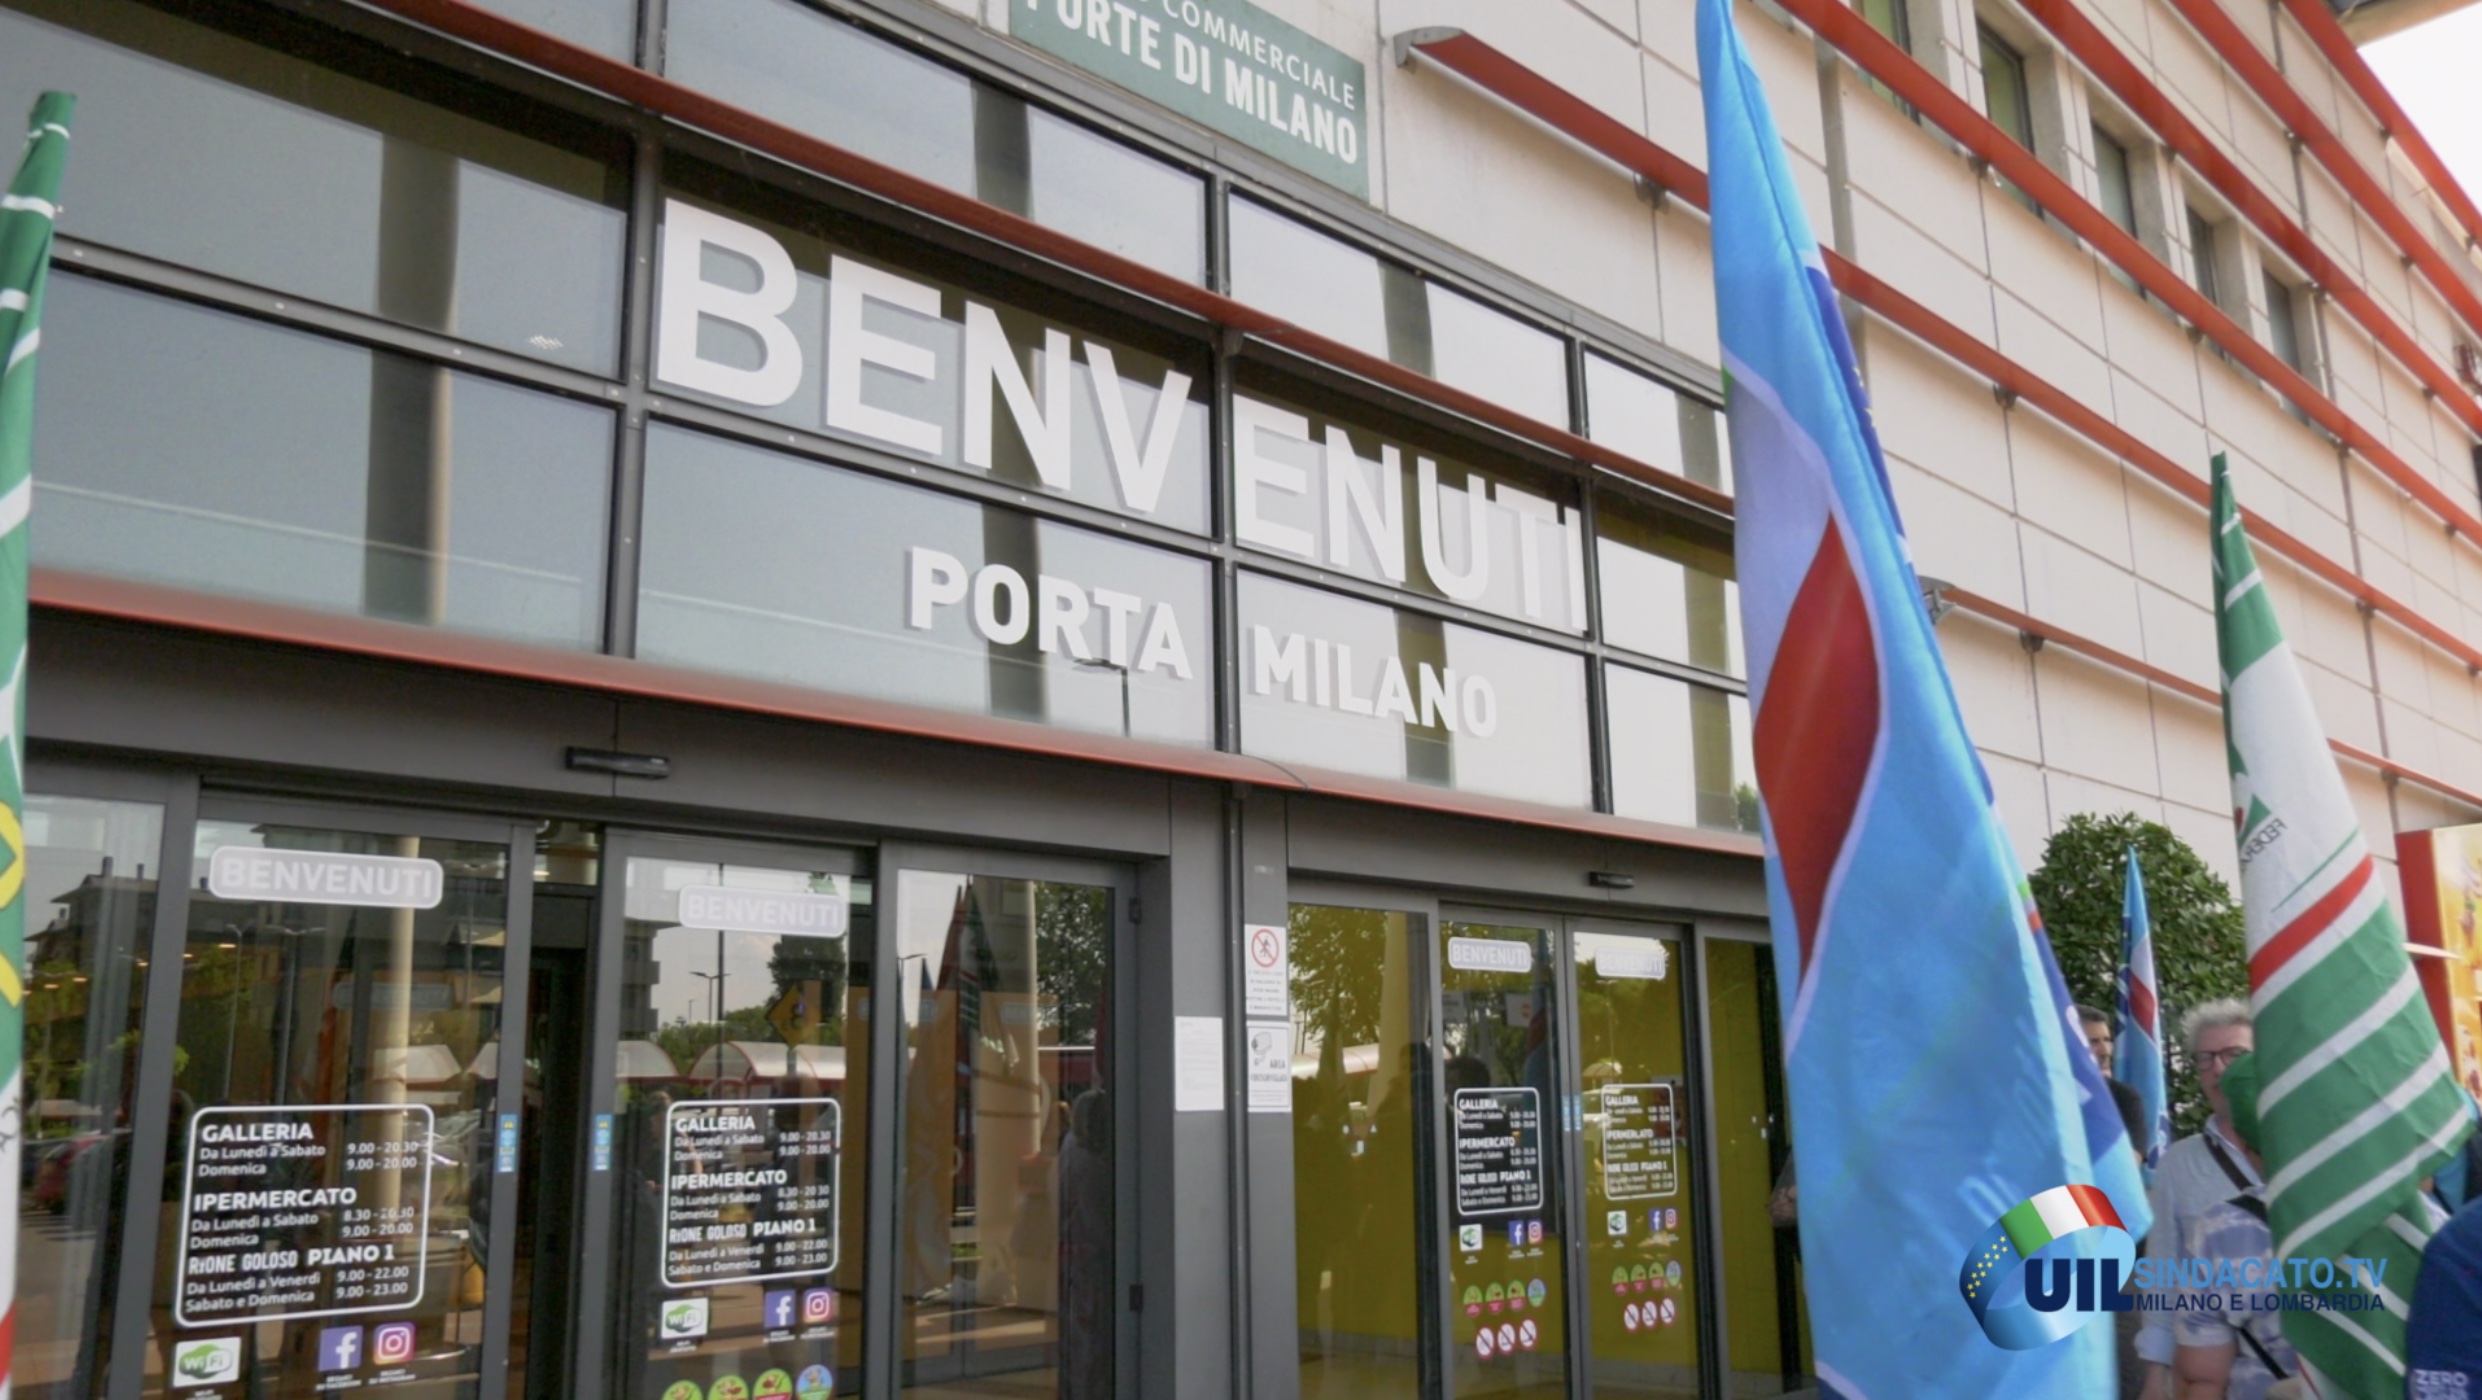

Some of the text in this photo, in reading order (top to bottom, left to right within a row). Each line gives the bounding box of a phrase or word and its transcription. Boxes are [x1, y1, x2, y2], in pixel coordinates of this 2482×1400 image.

[1163, 0, 1355, 110] COMMERCIALE
[1027, 0, 1357, 164] ORTE DI MILANO
[657, 198, 1588, 632] BENVENUTI
[910, 546, 1498, 738] PORTA MILANO
[222, 857, 433, 899] BENVENUTI
[688, 895, 839, 931] BENVENUTI
[1453, 944, 1528, 966] BENVENUTI
[202, 1123, 314, 1142] GALLERIA
[675, 1115, 755, 1132] GALLERIA
[200, 1148, 218, 1160] Da
[282, 1143, 326, 1156] Sabato
[348, 1143, 375, 1155] 9.00
[384, 1141, 418, 1153] 20.30
[199, 1162, 267, 1177] Domenica
[346, 1158, 373, 1171] 9.00
[383, 1157, 417, 1169] 20.00
[671, 1169, 787, 1190] IPERMERCATO
[194, 1187, 357, 1211] IPERMERCATO
[192, 1219, 210, 1232] Da
[274, 1213, 319, 1227] Sabato
[343, 1210, 370, 1222] 8.30
[753, 1219, 805, 1236] PIANO
[808, 1218, 816, 1232] 1
[191, 1234, 259, 1249] Domenica
[342, 1225, 370, 1238] 9.00
[380, 1223, 414, 1235] 20.00
[242, 1251, 298, 1271] GOLOSO
[308, 1245, 380, 1266] PIANO
[384, 1244, 395, 1261] 1
[187, 1282, 205, 1295] Da
[337, 1271, 365, 1283] 9.00
[374, 1267, 408, 1279] 22.00
[186, 1299, 233, 1313] Sabato
[248, 1291, 315, 1306] Domenica
[336, 1286, 363, 1299] 9.00
[374, 1283, 408, 1296] 23.00
